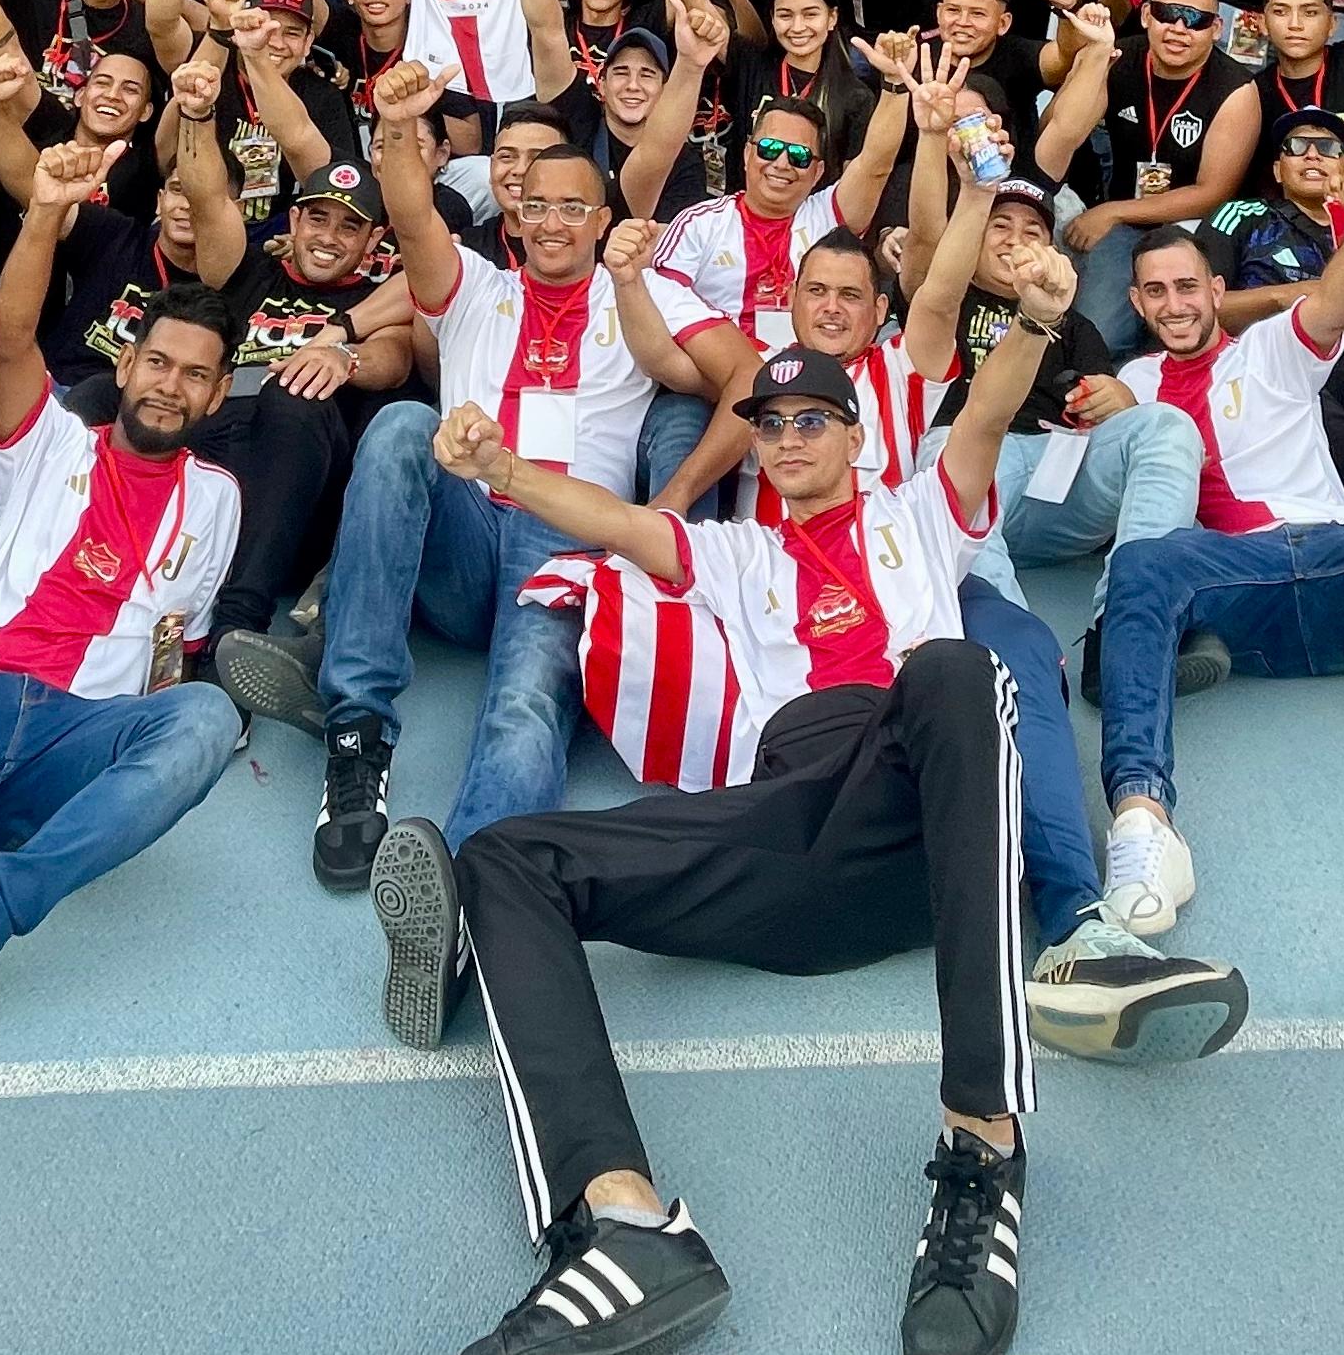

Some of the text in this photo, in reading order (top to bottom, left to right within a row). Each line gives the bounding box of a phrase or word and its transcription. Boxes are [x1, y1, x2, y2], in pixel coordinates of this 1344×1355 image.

[595, 307, 617, 348] J
[1222, 377, 1243, 420] J
[160, 530, 199, 582] J
[874, 522, 904, 571] J
